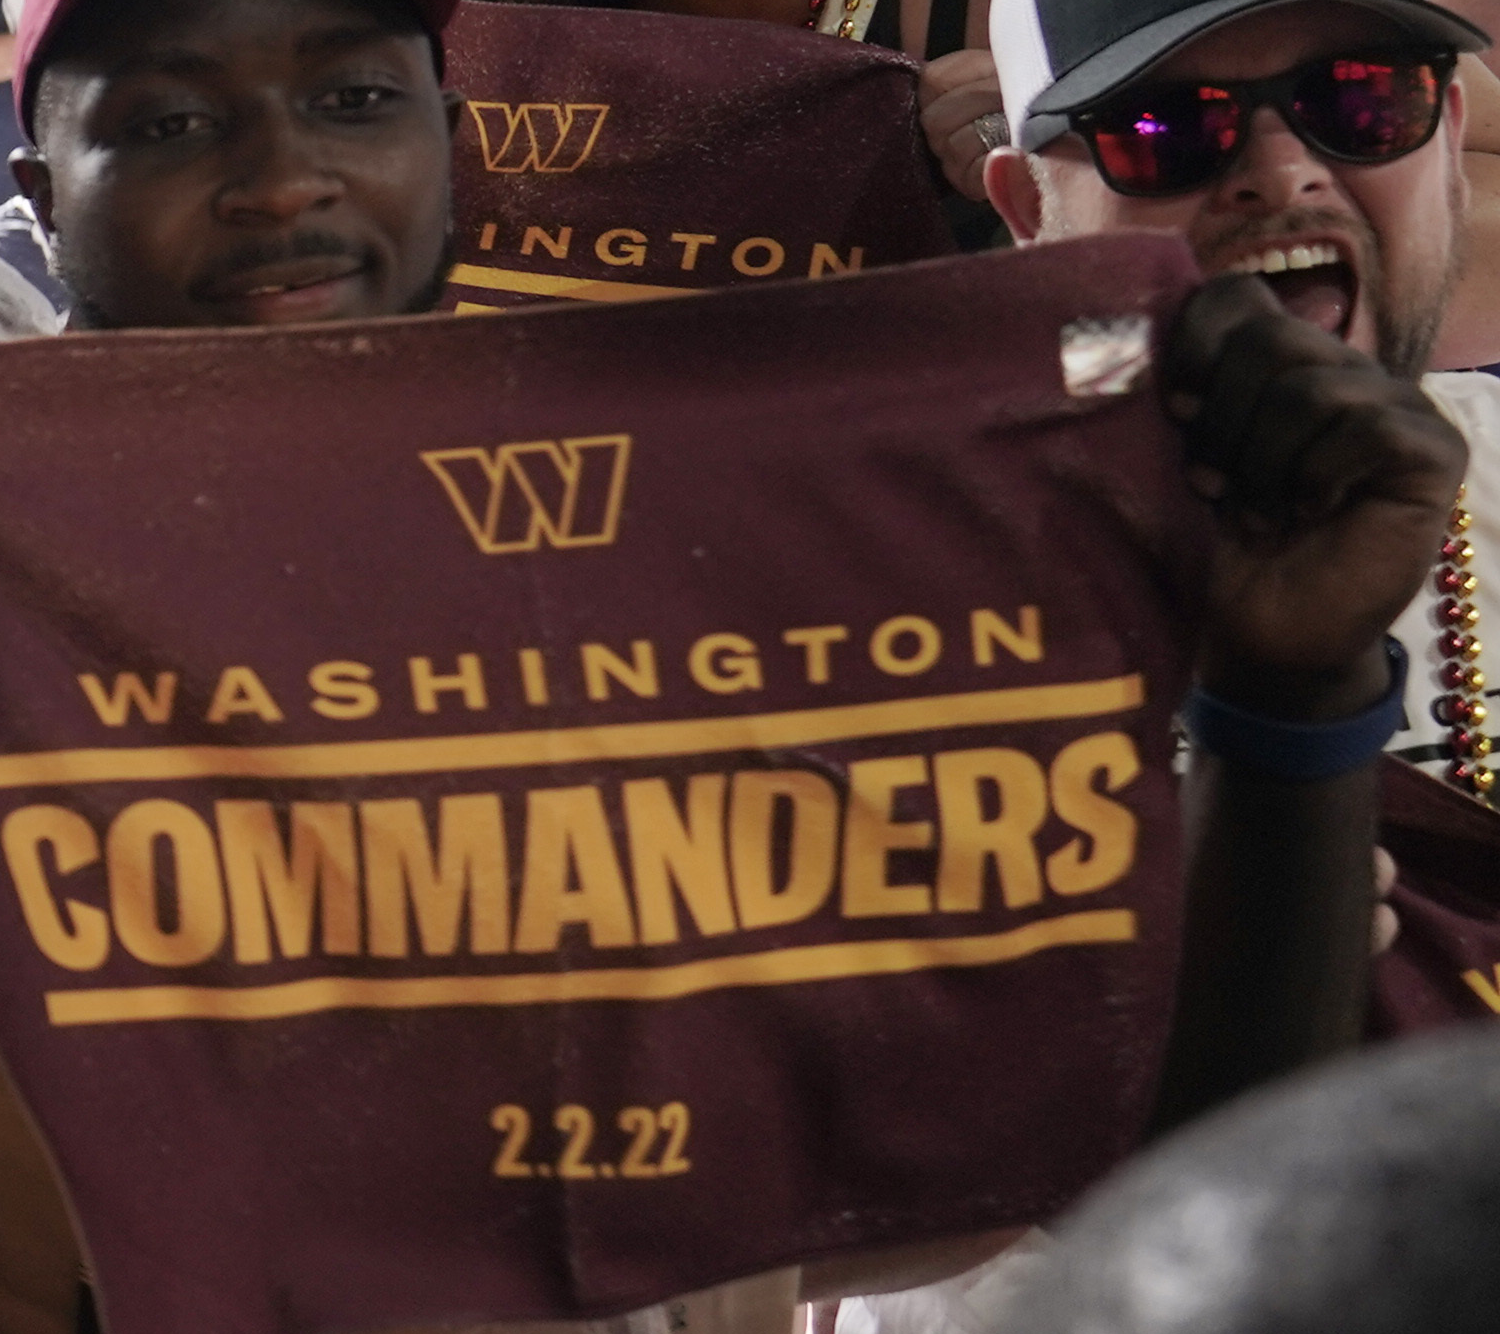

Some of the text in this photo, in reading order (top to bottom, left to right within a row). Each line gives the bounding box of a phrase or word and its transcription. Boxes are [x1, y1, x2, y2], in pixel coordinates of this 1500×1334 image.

[478, 221, 865, 281] INGTON
[420, 435, 631, 555] W
[79, 607, 1046, 727] WASHINGTON
[2, 732, 1137, 972] COMMANDERS
[491, 1102, 691, 1180] 2.2.22
